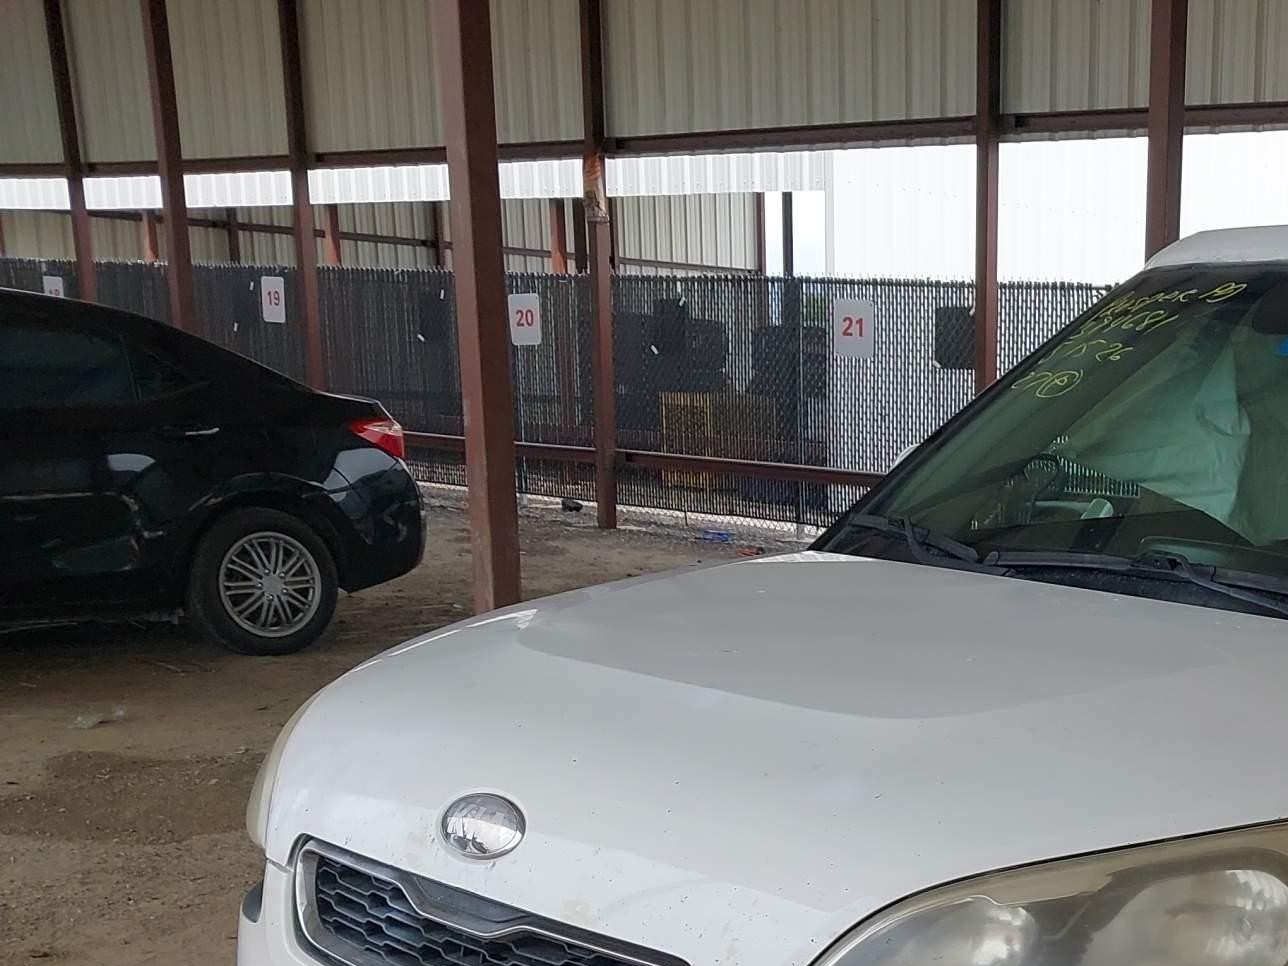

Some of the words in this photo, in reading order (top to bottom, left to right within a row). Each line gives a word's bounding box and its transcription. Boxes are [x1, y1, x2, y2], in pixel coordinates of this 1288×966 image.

[266, 290, 281, 306] 19
[515, 309, 535, 327] 20
[841, 317, 865, 337] 21
[1095, 343, 1134, 361] 26
